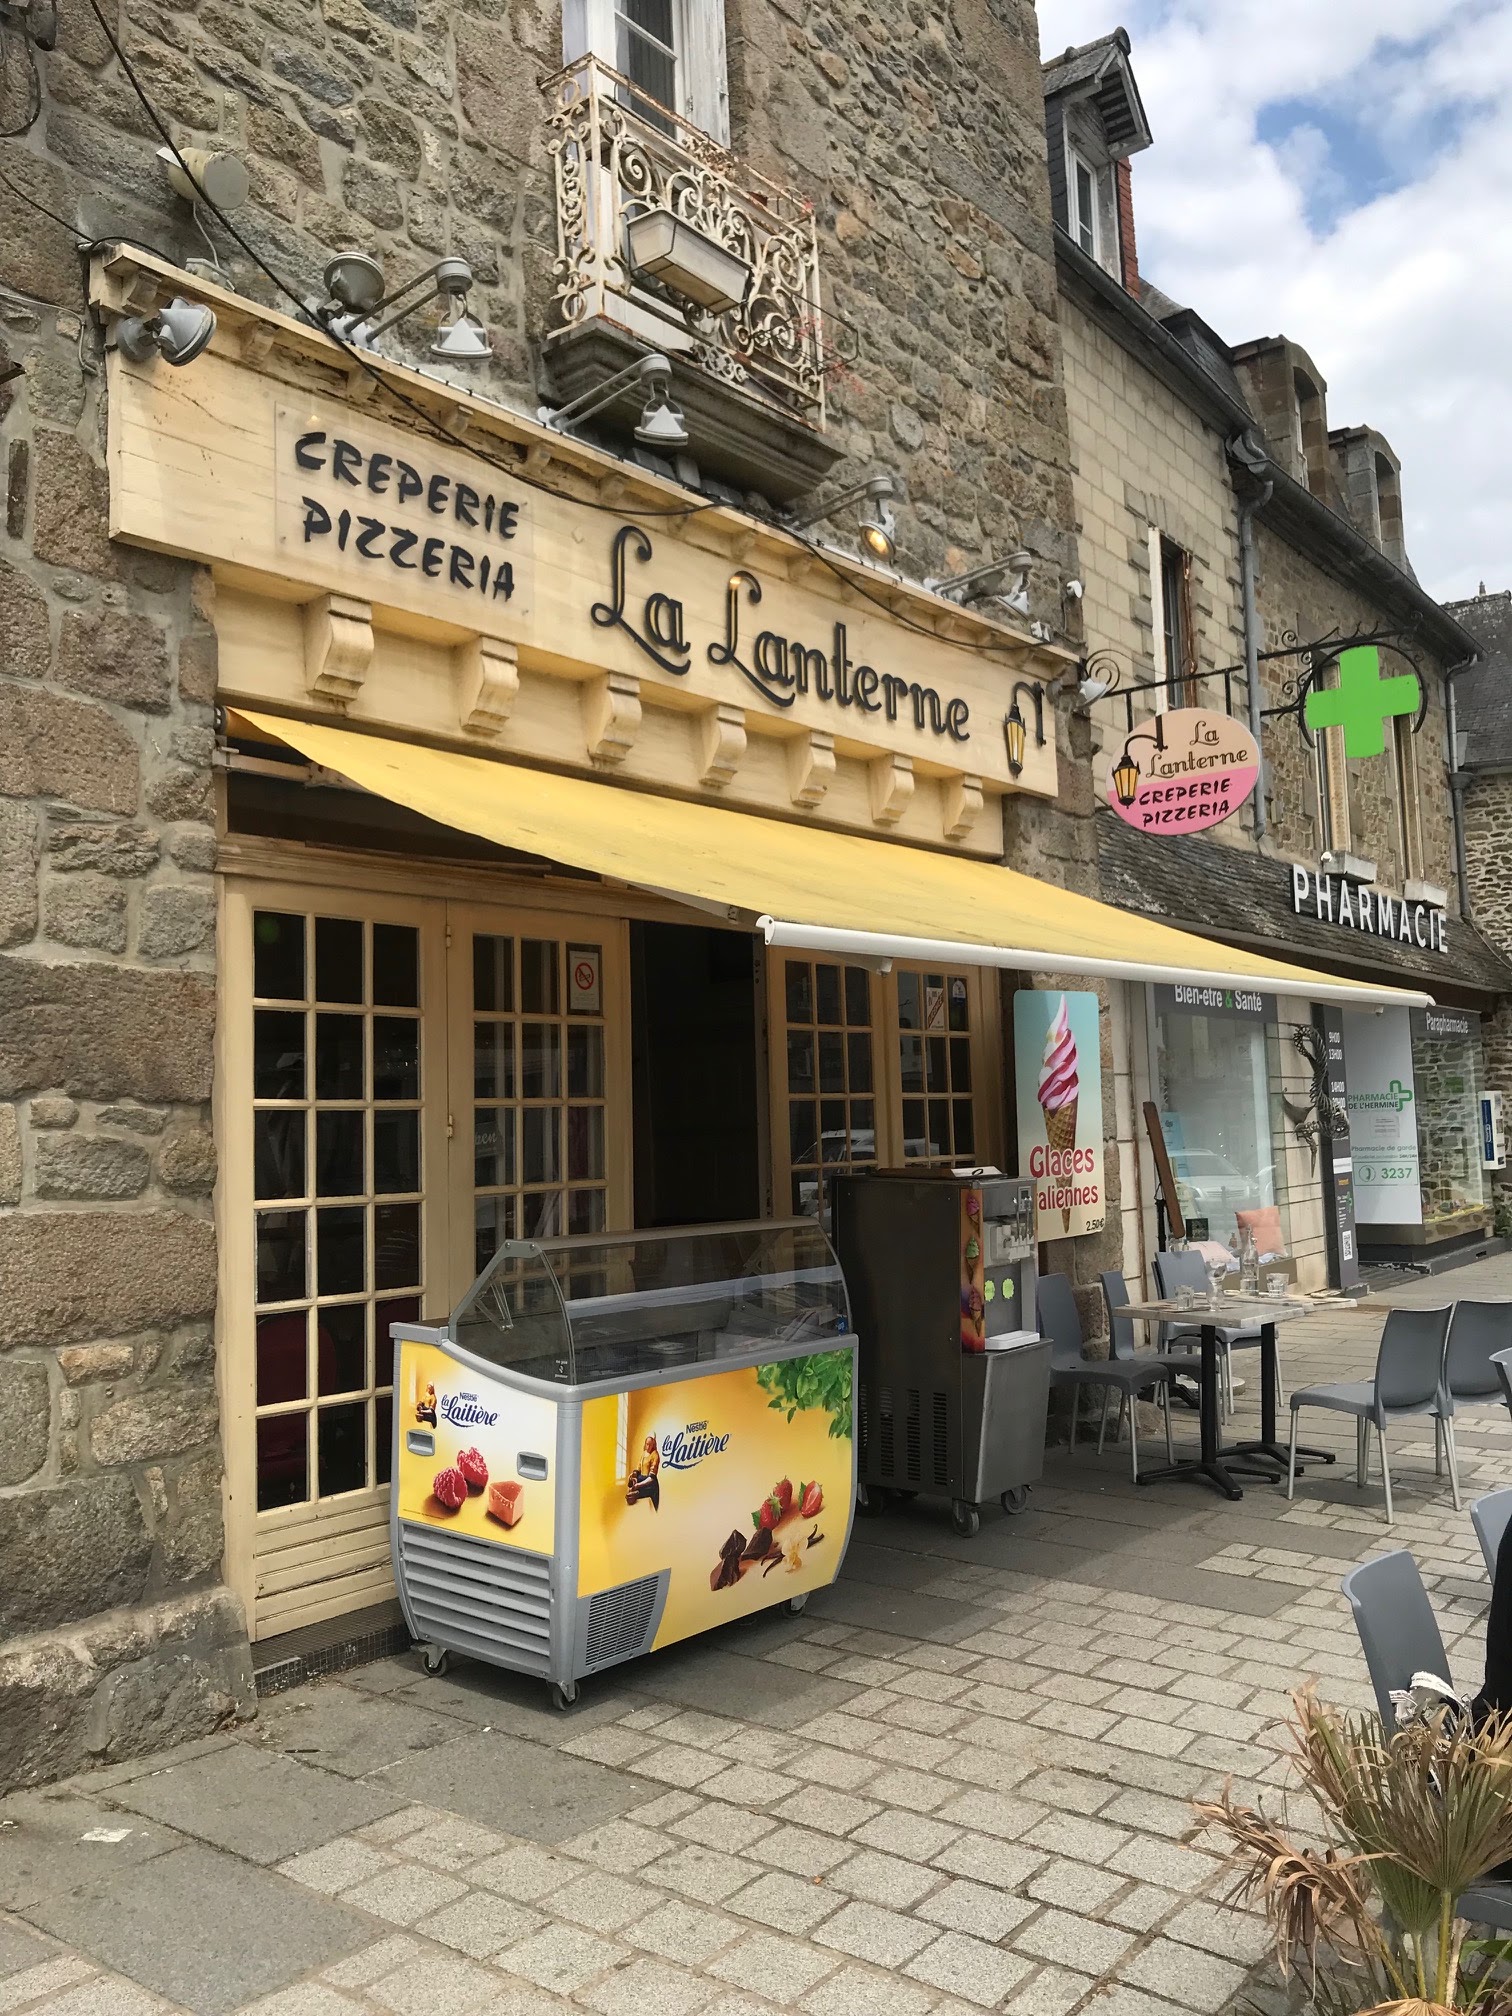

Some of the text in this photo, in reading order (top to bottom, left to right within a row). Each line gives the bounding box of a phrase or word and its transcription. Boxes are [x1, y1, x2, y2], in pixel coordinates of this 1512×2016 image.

[295, 431, 519, 539] CREPERIE
[301, 496, 515, 602] PIZZERIA
[591, 525, 970, 742] La Lanterne
[1189, 720, 1219, 746] La
[1146, 749, 1248, 779] Lanterne
[1139, 778, 1231, 805] CREPERIE
[1143, 800, 1229, 827] PIZZERIA
[1292, 863, 1448, 954] PHARMACIE
[1234, 990, 1262, 1012] Santé
[1426, 1011, 1469, 1036] Parapharmacie
[1328, 1048, 1343, 1060] 13H00
[1347, 1092, 1399, 1102] PHARMACIE
[1348, 1102, 1358, 1110] DE
[1030, 1145, 1095, 1178] Glaces
[1381, 1168, 1412, 1179] 3237
[1037, 1185, 1099, 1211] aliennes
[1085, 1218, 1105, 1232] 2.50€
[441, 1396, 498, 1428] Laitière
[662, 1432, 730, 1470] Laitière
